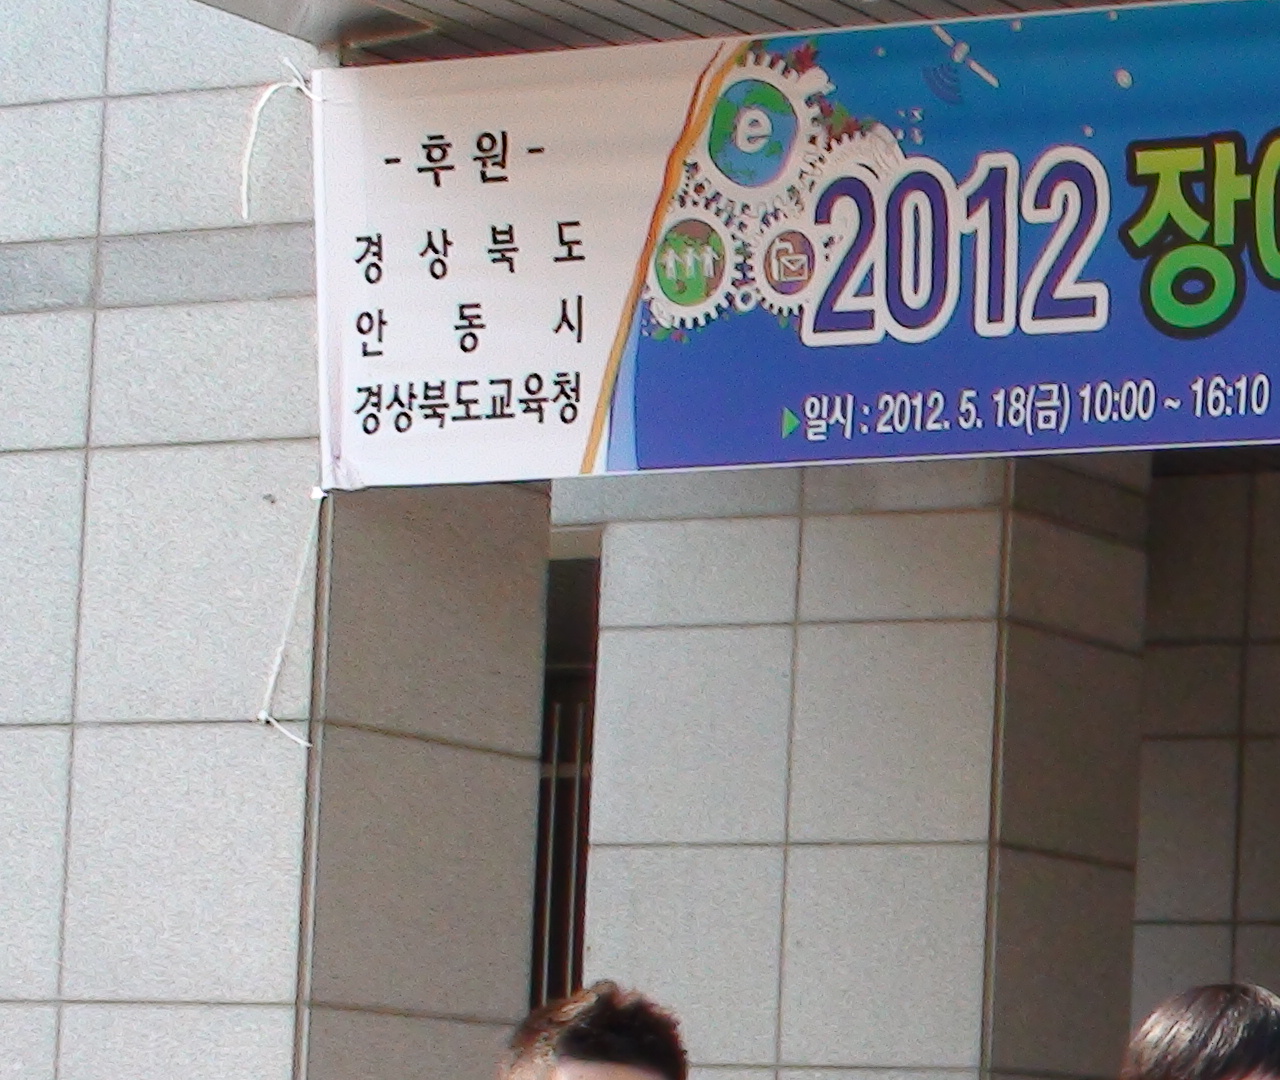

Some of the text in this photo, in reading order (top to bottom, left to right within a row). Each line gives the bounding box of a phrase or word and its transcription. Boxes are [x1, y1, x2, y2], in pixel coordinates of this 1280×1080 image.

[803, 150, 1108, 344] 2012
[354, 371, 582, 436] 경상북도교육청
[876, 391, 950, 435] 2012.
[959, 389, 983, 430] 5.
[993, 381, 1070, 436] 18(금)
[1080, 379, 1156, 424] 10:00
[1190, 373, 1270, 418] 16:10
